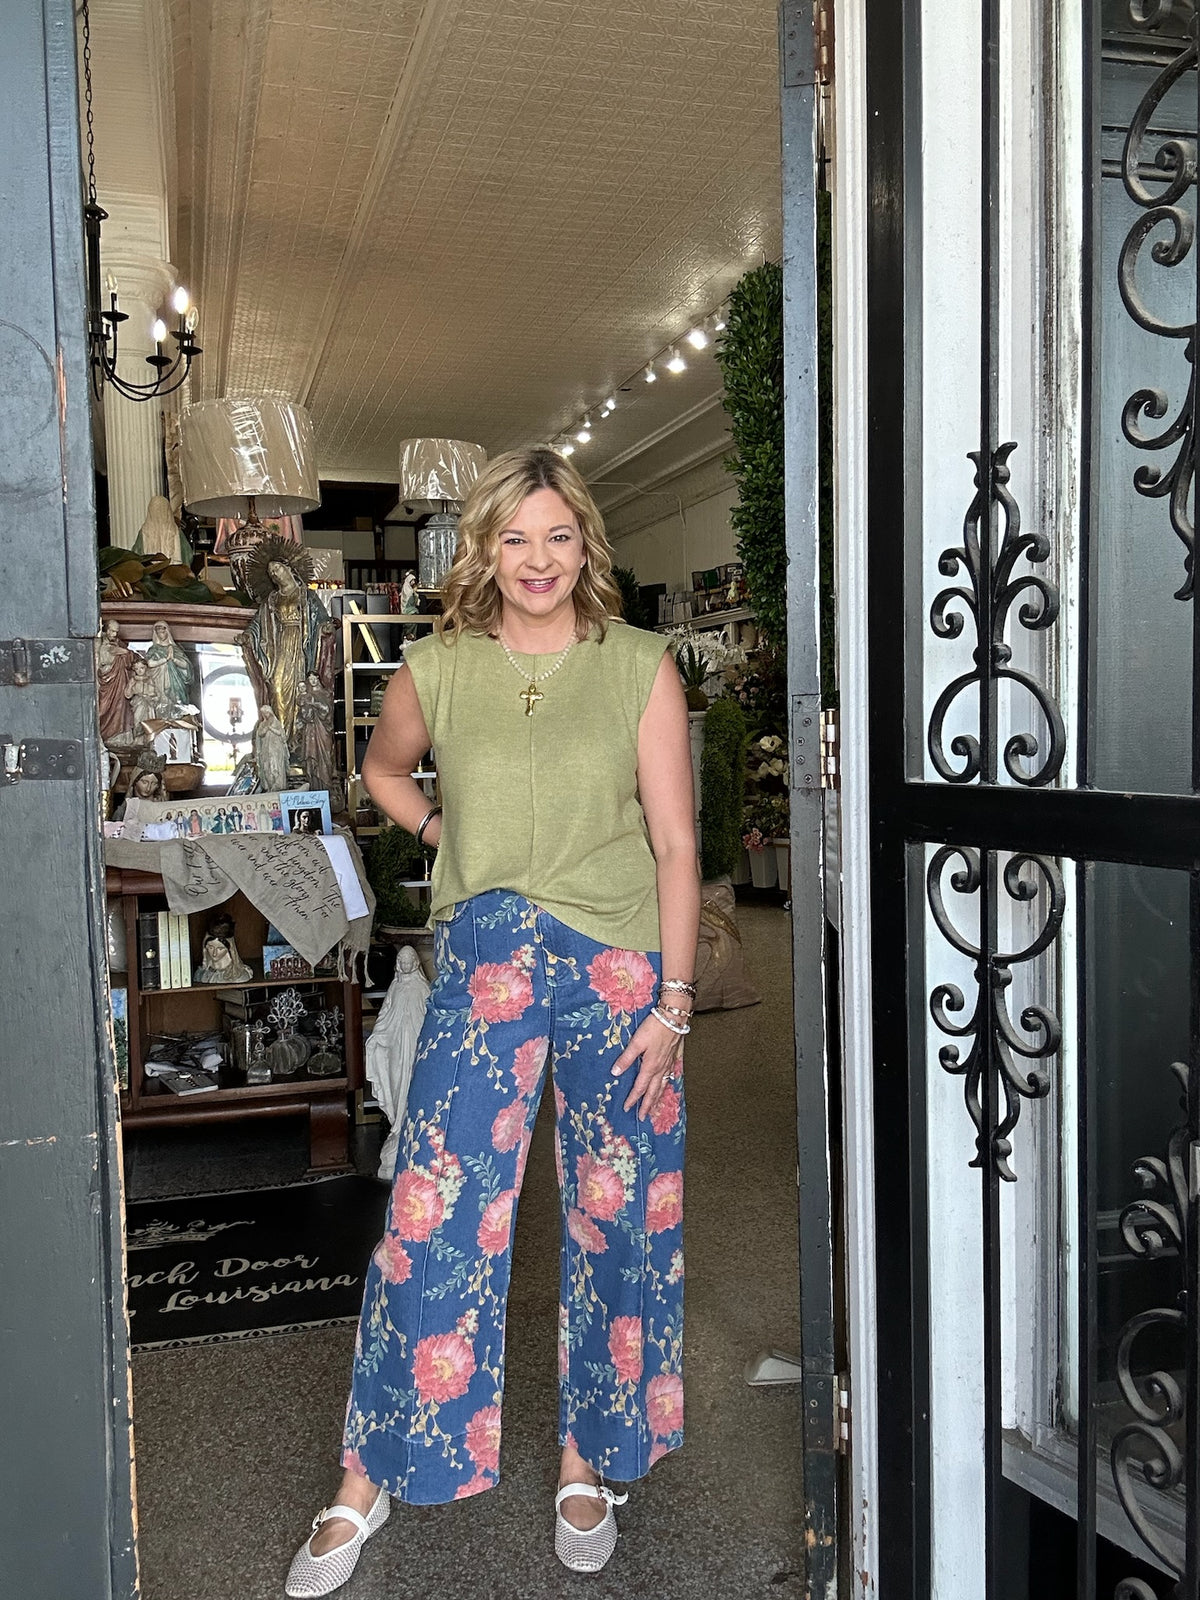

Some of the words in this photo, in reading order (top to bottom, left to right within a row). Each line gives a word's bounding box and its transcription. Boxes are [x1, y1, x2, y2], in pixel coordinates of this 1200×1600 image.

[127, 1261, 199, 1289] nch
[213, 1254, 320, 1278] Door
[158, 1273, 360, 1313] Louisiana
